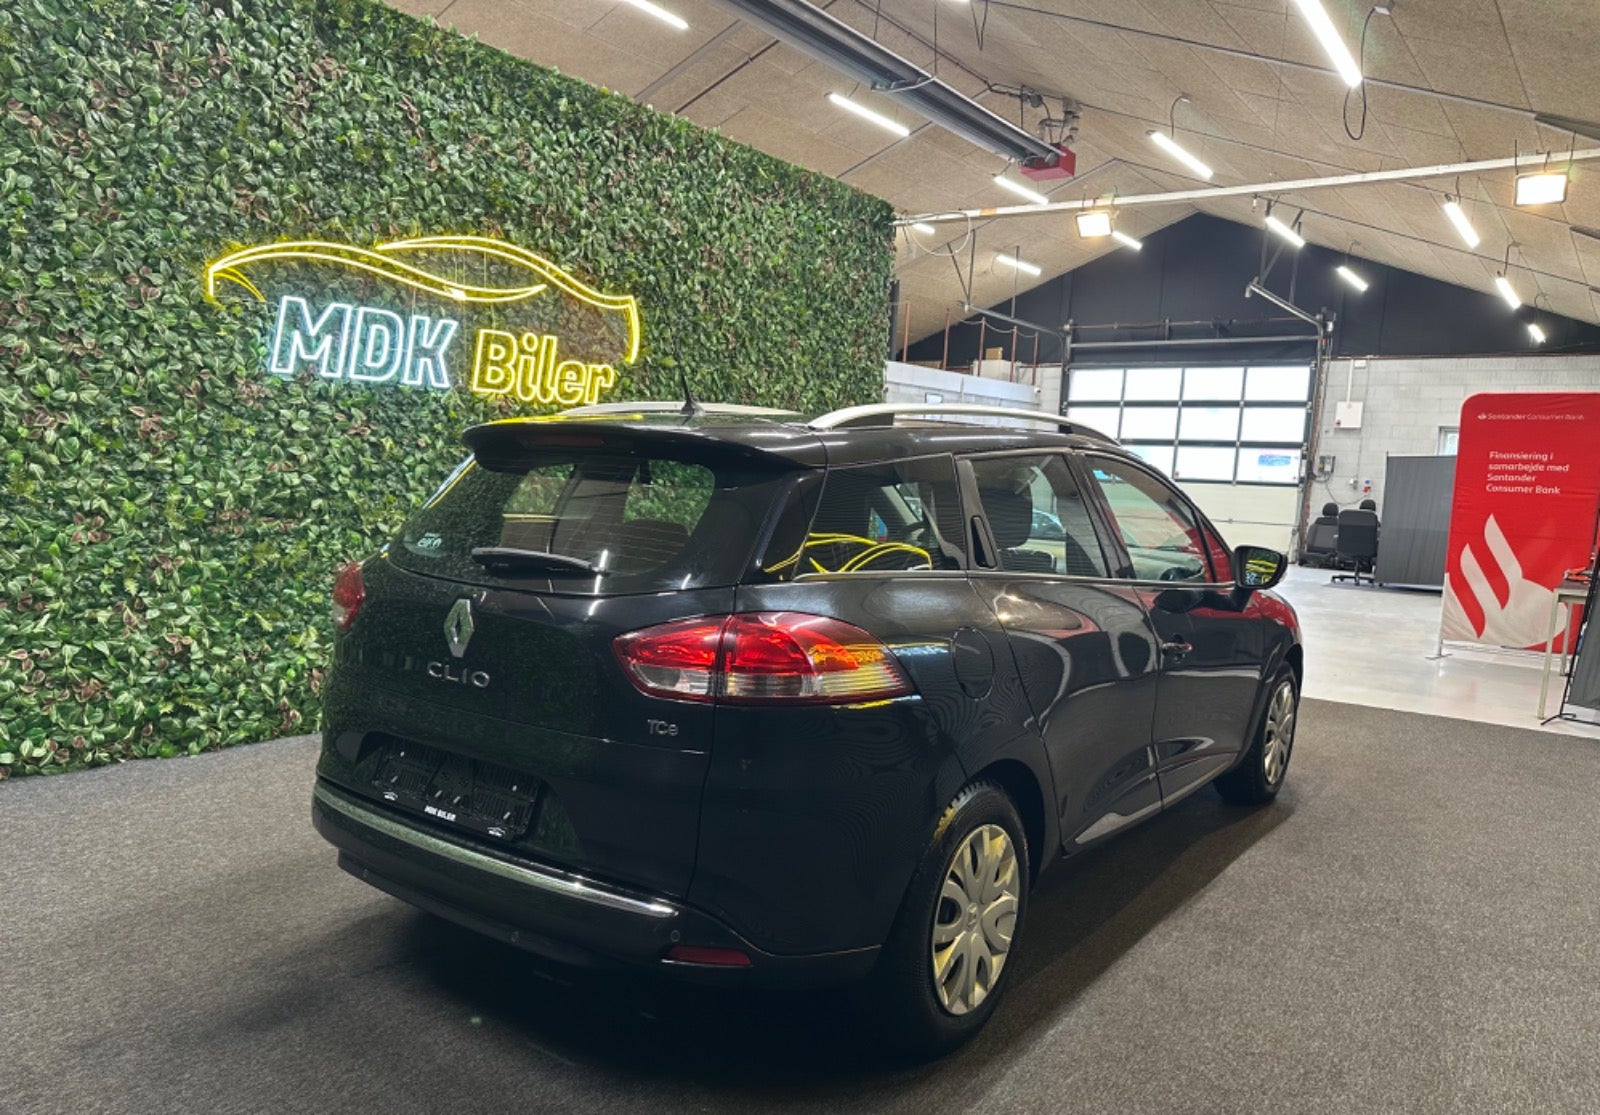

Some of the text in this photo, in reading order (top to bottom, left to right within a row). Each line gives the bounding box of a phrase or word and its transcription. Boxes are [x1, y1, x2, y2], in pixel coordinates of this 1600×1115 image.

[270, 295, 616, 405] MDK Biler
[1489, 451, 1548, 461] Finansiering
[1488, 462, 1569, 472] samarbejde med
[1487, 473, 1536, 482] Santander
[1485, 483, 1561, 494] Consumer Bank
[426, 661, 490, 688] CLIO
[647, 719, 679, 736] TCe
